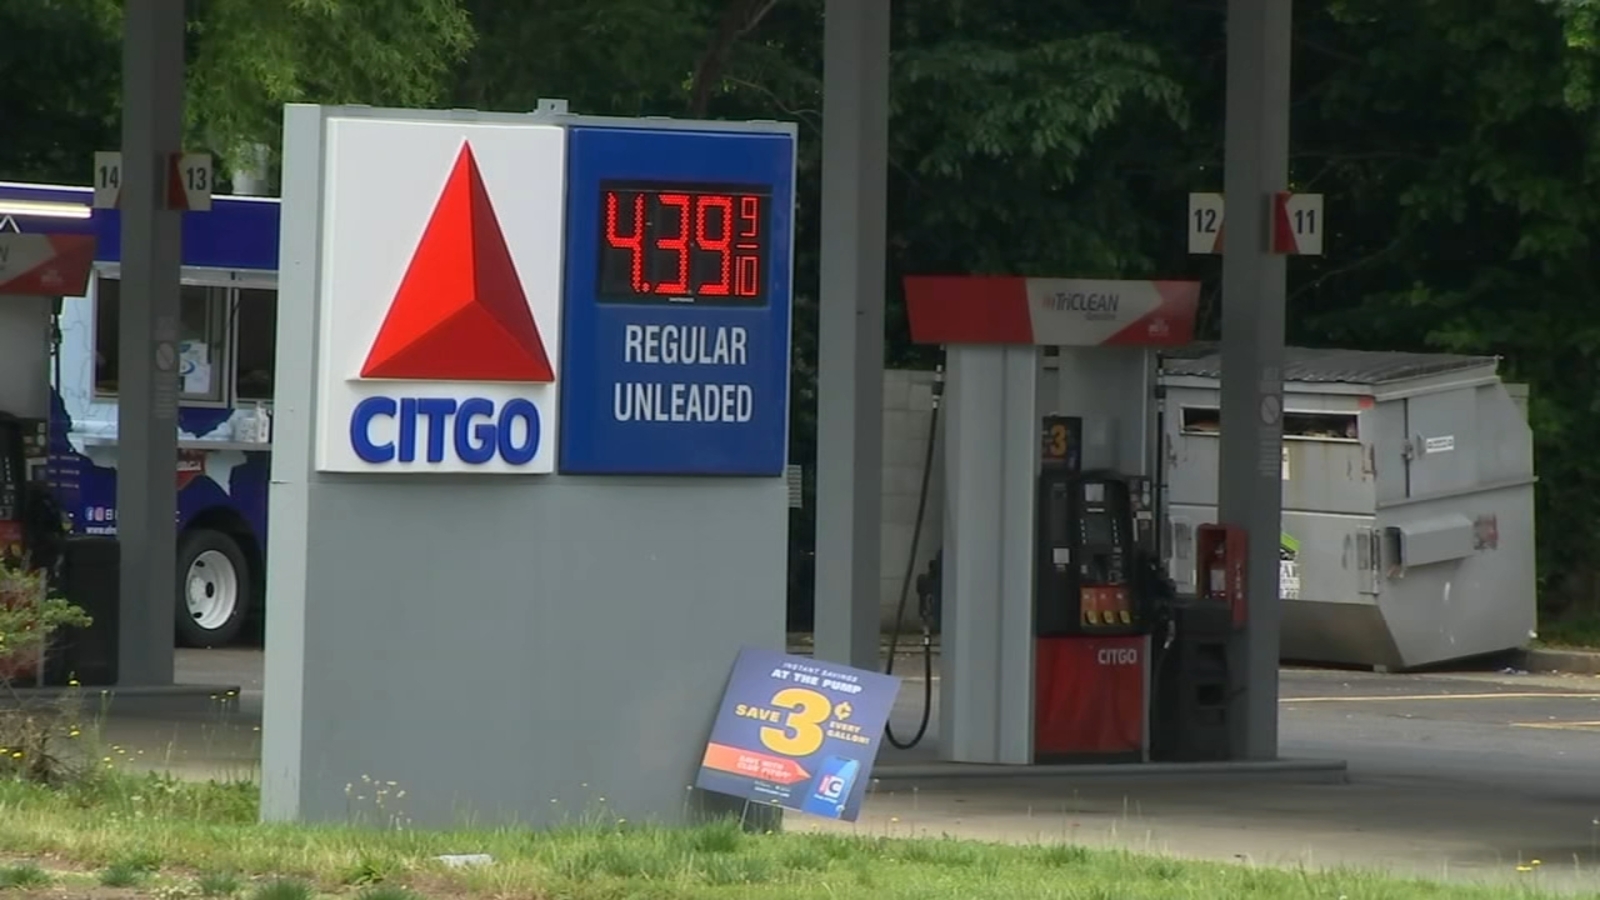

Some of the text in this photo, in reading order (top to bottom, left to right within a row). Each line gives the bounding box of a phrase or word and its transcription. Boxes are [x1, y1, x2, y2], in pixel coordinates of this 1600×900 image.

[100, 166, 119, 189] 14
[186, 167, 207, 190] 13
[1193, 209, 1216, 234] 12
[1294, 209, 1316, 235] 11
[606, 192, 758, 295] 4.39 9
[735, 256, 758, 295] 10
[624, 324, 747, 365] REGULAR
[614, 382, 753, 422] UNLEADED
[350, 396, 541, 465] CITGO
[1098, 649, 1138, 665] CITGO
[771, 668, 862, 694] AT THE PUMP
[735, 704, 781, 723] SAVE
[829, 721, 861, 733] EVERY
